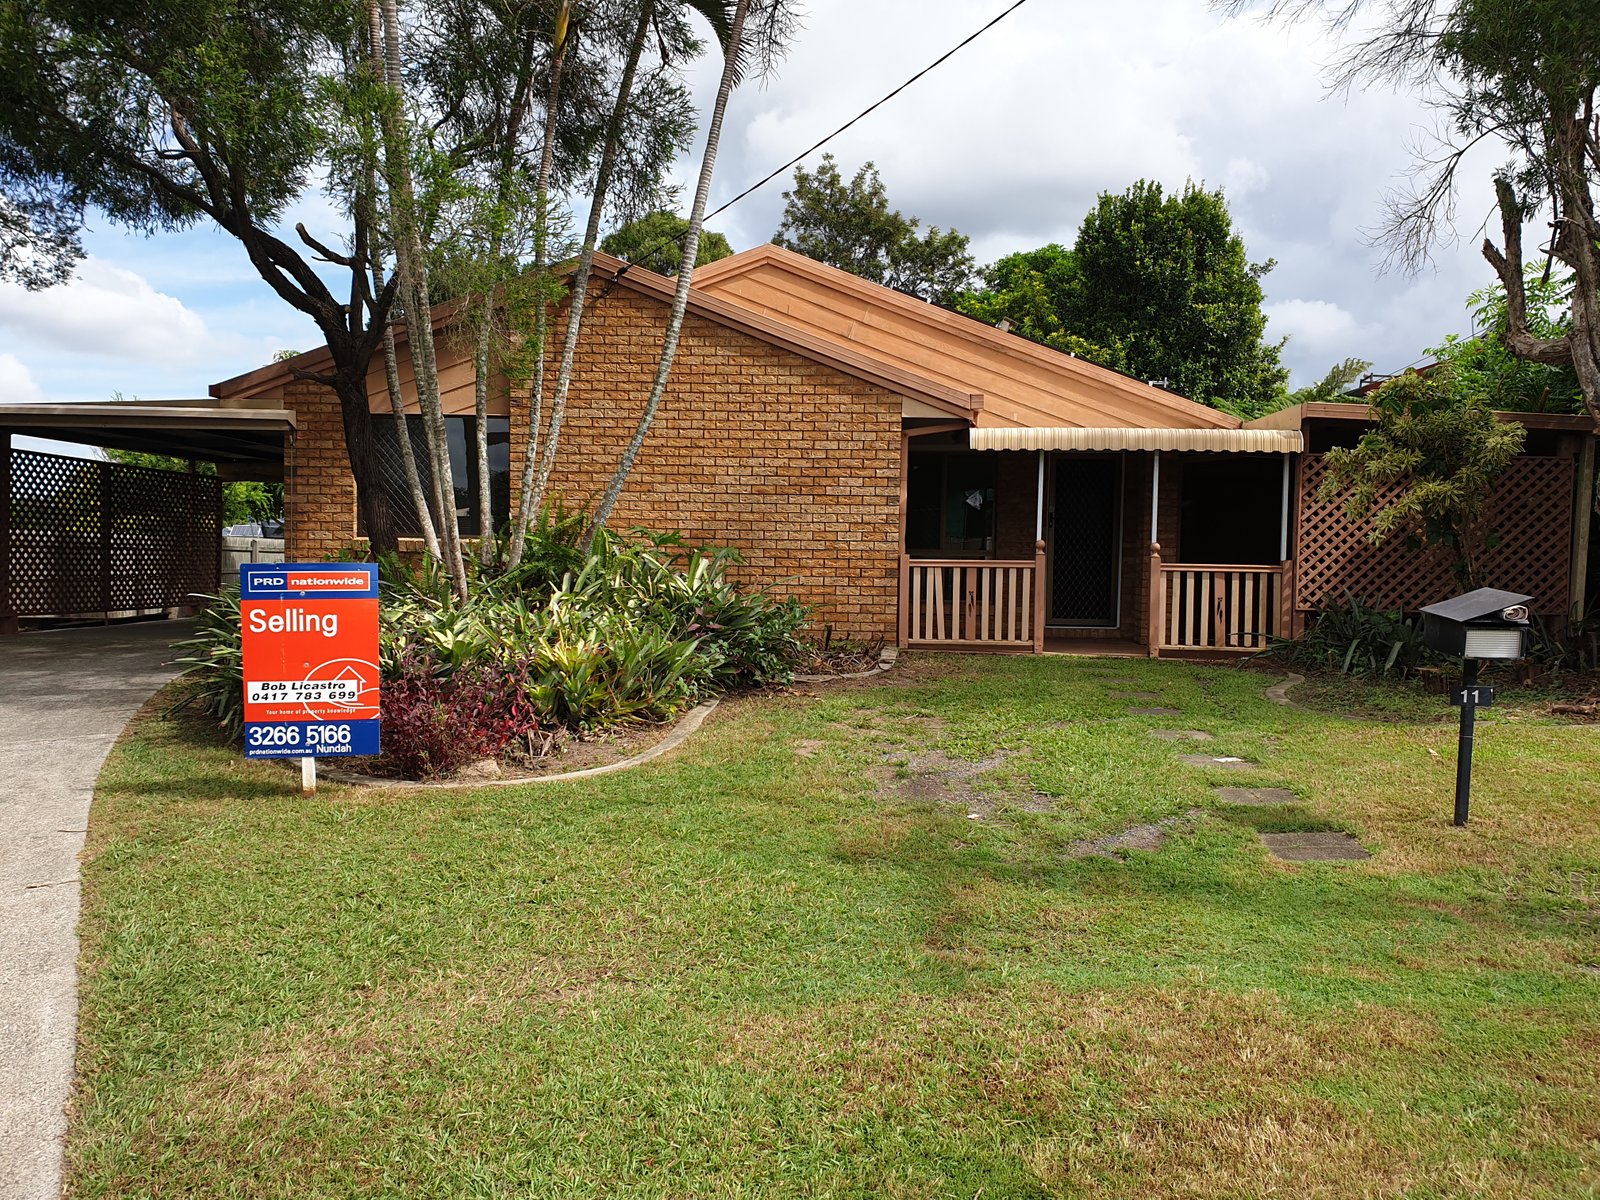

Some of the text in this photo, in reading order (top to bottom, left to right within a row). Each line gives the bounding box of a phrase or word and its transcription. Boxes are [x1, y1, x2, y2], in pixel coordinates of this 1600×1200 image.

[254, 577, 364, 586] PRD nationwide
[249, 608, 338, 637] Selling
[261, 682, 346, 691] Bob Licastro
[252, 693, 288, 701] 0417
[329, 691, 355, 699] 699
[1461, 690, 1479, 703] 11
[249, 725, 351, 746] 3266 5166
[316, 744, 351, 753] Nundah
